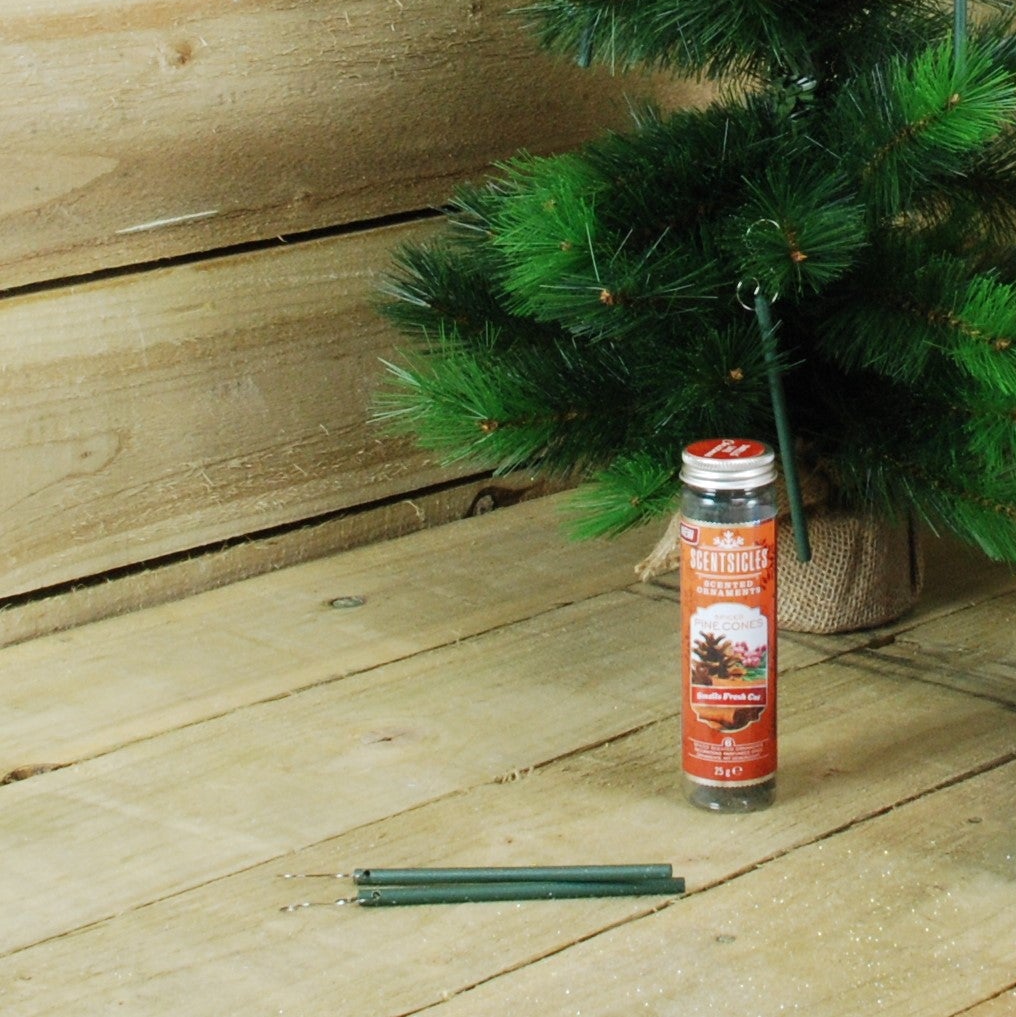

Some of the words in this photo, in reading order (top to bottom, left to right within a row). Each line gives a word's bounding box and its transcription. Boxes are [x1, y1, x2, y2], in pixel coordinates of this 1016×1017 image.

[690, 547, 769, 574] SCENTSICLES
[704, 579, 753, 589] SCENTED
[697, 586, 762, 597] ORNAMENTS
[721, 618, 764, 632] CONES
